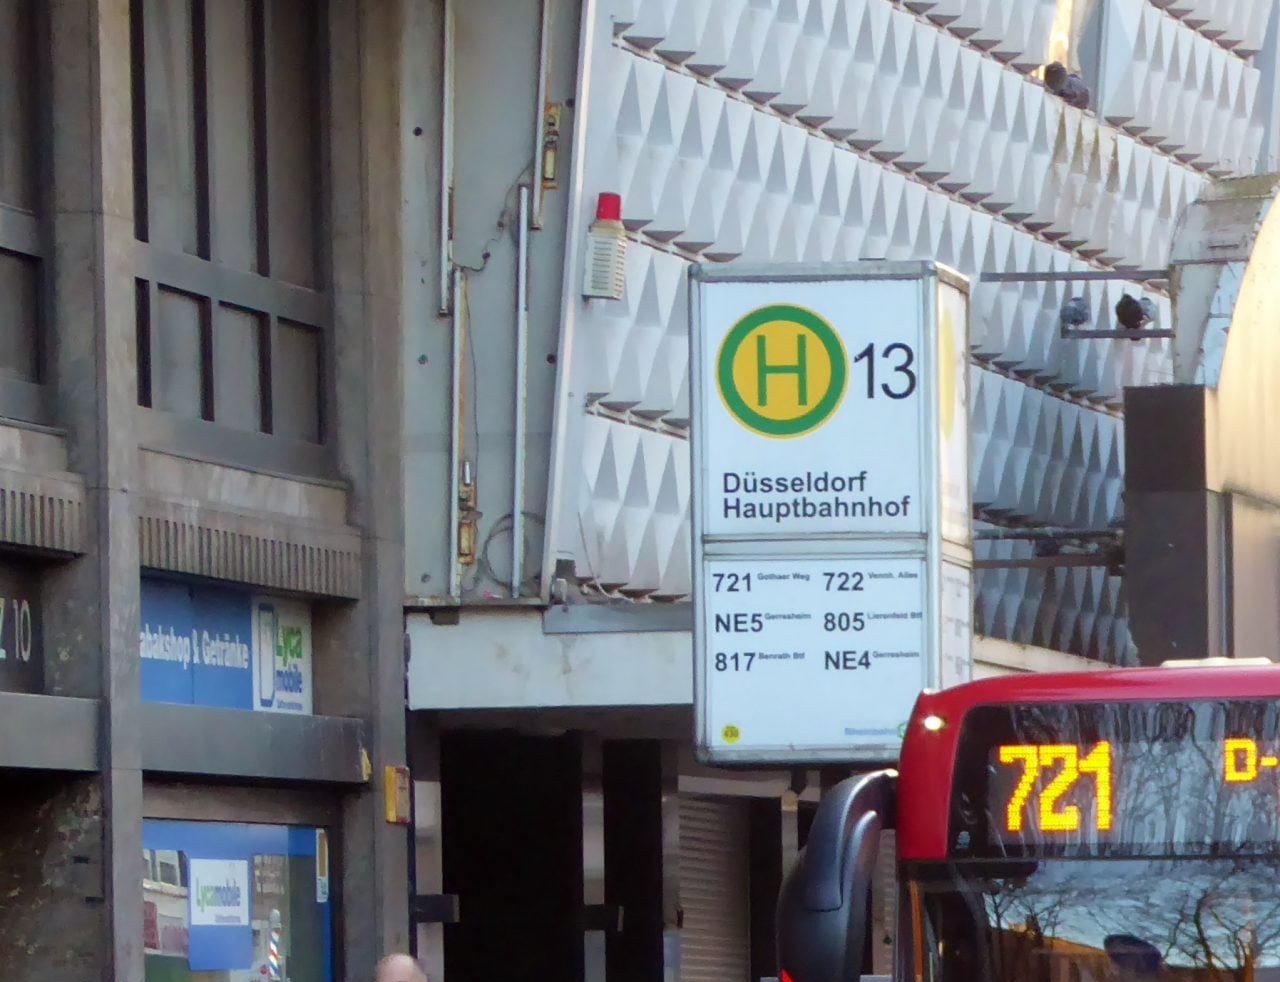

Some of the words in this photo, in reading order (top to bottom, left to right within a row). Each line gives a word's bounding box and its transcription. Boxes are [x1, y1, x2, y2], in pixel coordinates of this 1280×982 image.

[757, 334, 808, 407] H
[853, 342, 917, 400] 13
[723, 471, 867, 493] Düsseldorf
[723, 496, 911, 522] Hauptbahnhof
[713, 573, 752, 592] 721
[757, 573, 791, 581] Gothaer
[792, 572, 811, 582] Weg
[823, 572, 864, 591] 722
[13, 599, 32, 662] 10
[715, 613, 763, 633] NE5
[824, 612, 865, 632] 805
[139, 623, 191, 670] abakshop
[202, 630, 249, 669] Getränke
[715, 653, 756, 672] 817
[824, 651, 872, 670] NE4
[999, 741, 1112, 831] 721
